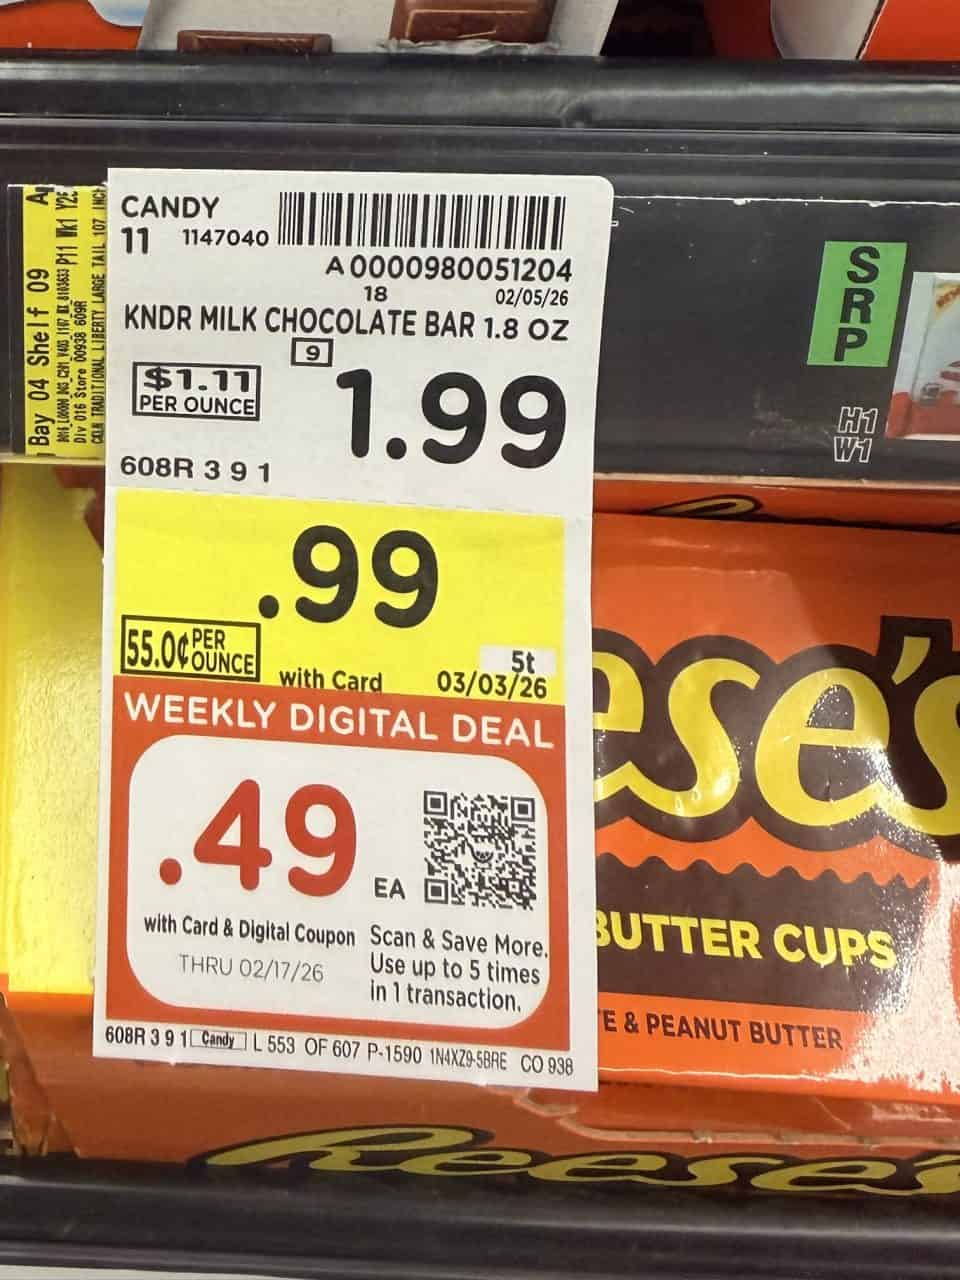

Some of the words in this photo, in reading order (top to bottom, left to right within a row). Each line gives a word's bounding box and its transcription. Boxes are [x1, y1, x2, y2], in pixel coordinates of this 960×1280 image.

[121, 195, 219, 219] CANDY
[122, 228, 149, 254] 11
[182, 229, 269, 247] 1147040
[26, 267, 49, 291] 09
[364, 286, 387, 301] 18
[496, 287, 569, 307] 02/05/26
[26, 306, 49, 367] Shelf
[125, 304, 192, 330] KNDR
[200, 307, 257, 331] MILK
[264, 308, 416, 335] CHOCOLATE
[425, 311, 474, 337] BAR
[484, 317, 518, 339] 1.8
[528, 319, 569, 341] OZ
[306, 345, 321, 361] 9
[27, 377, 49, 401] 04
[74, 368, 87, 397] Store
[144, 367, 249, 392] $1.11
[140, 396, 179, 413] PER
[186, 397, 256, 416] OUNCE
[336, 368, 567, 469] 1.99
[838, 407, 879, 434] H1
[27, 412, 55, 445] Bay
[834, 436, 872, 463] W1
[120, 456, 194, 478] 608R
[203, 459, 220, 480] 3
[231, 461, 247, 482] 9
[259, 464, 269, 483] 1
[258, 525, 439, 628] .99
[126, 628, 189, 669] 55.0¢
[192, 628, 225, 649] PER
[192, 652, 253, 674] OUNCE
[280, 668, 325, 688] with
[332, 671, 382, 693] Card
[437, 671, 546, 700] 03/03/26
[123, 692, 277, 729] WEEKLY
[290, 706, 437, 740] DIGITAL
[452, 718, 553, 748] DEAL
[159, 778, 357, 896] .49
[374, 877, 406, 899] EA
[144, 915, 176, 935] with
[182, 917, 218, 937] Card
[223, 918, 234, 937] &
[239, 920, 290, 944] Digital
[295, 924, 356, 948] Coupon
[370, 925, 416, 948] Scan
[422, 929, 436, 949] &
[442, 930, 488, 953] Save
[495, 934, 548, 958] More.
[774, 922, 897, 969] CUPS
[179, 953, 232, 976] THRU
[240, 959, 324, 983] 02/17/26
[370, 952, 405, 974] Use
[412, 960, 436, 980] up
[443, 959, 465, 978] to
[470, 963, 480, 980] 5
[488, 963, 540, 985] times
[370, 981, 386, 1002] in
[407, 983, 521, 1012] transaction.
[624, 1011, 639, 1033] &
[646, 1013, 741, 1042] PEANUT
[750, 1021, 843, 1050] BUTTER
[106, 1027, 146, 1047] 608R
[151, 1028, 160, 1047] 3
[164, 1030, 175, 1048] 9
[202, 1033, 234, 1049] Candy
[267, 1035, 295, 1054] 553
[305, 1038, 328, 1056] OF
[332, 1040, 360, 1058] 607
[367, 1044, 422, 1064] P-1590
[520, 1054, 543, 1074] CO
[548, 1056, 573, 1076] 938
